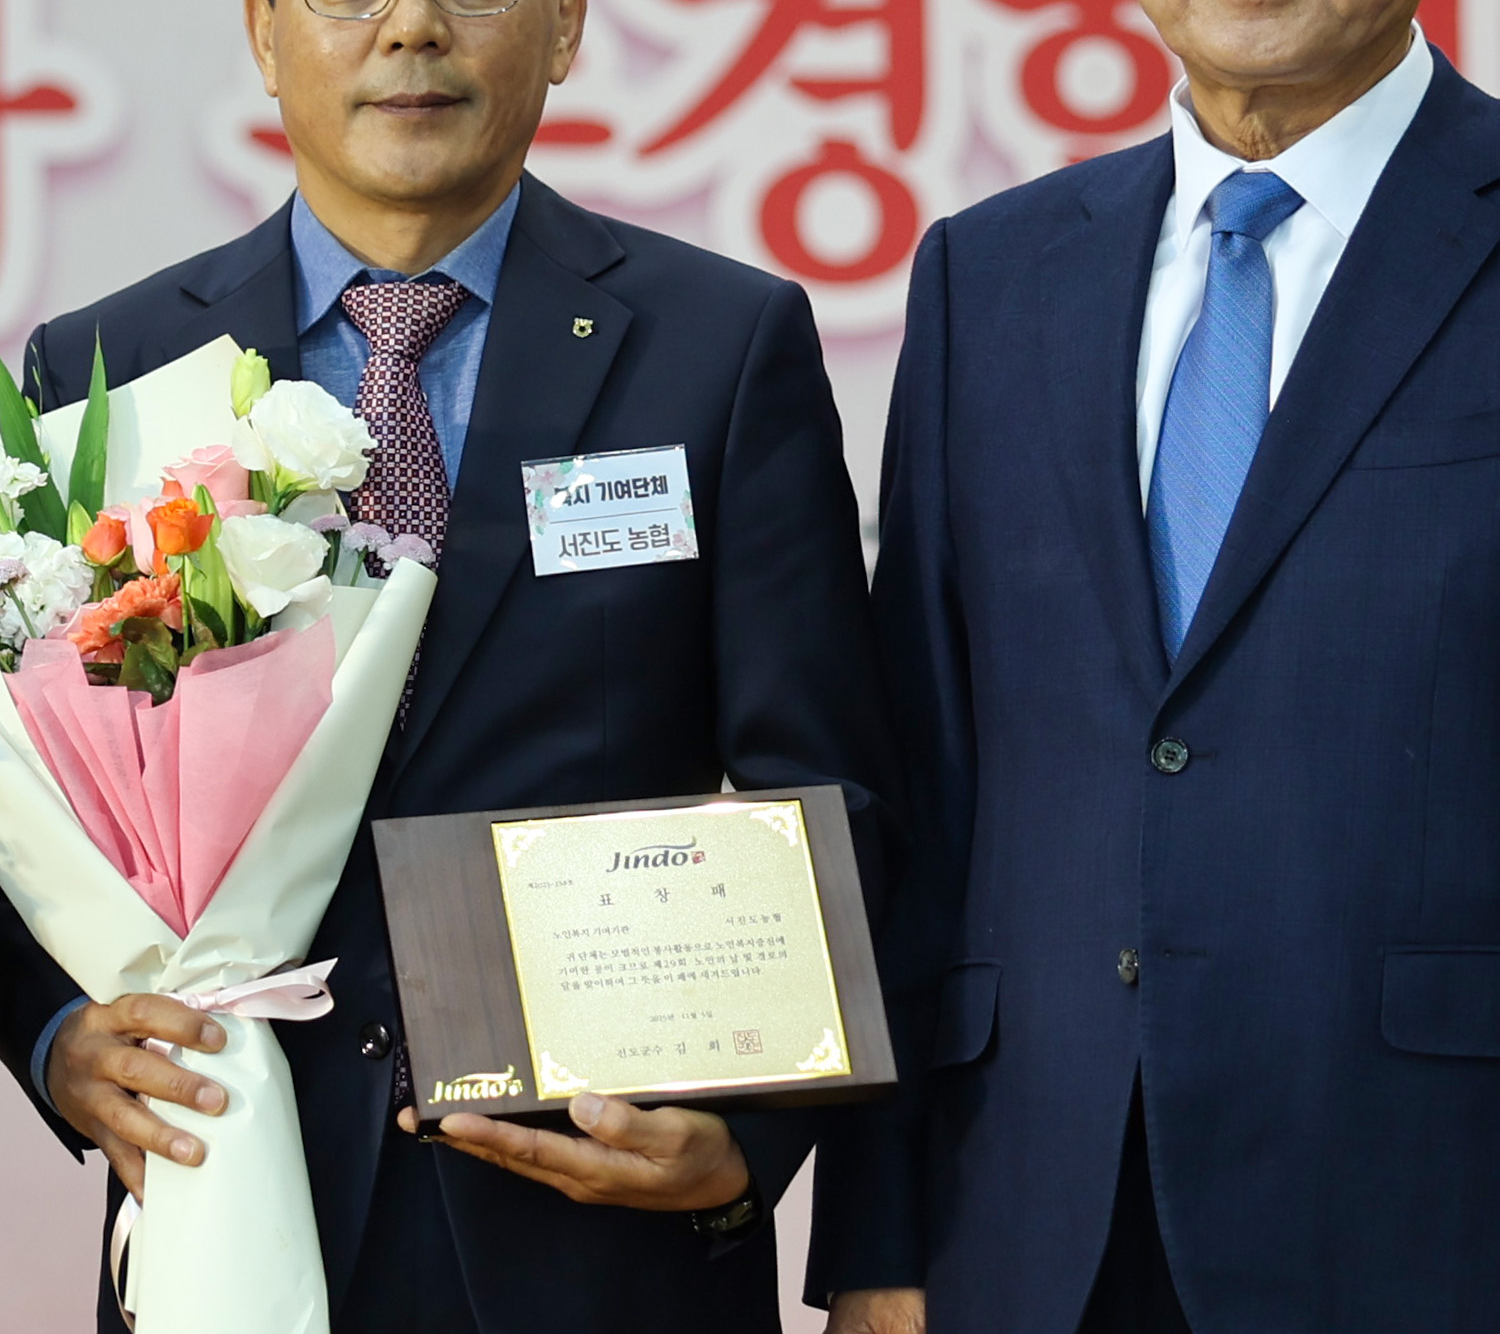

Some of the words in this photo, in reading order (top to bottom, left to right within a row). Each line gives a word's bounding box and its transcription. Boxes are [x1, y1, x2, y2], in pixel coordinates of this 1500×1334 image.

[595, 475, 669, 501] 기여단체
[559, 528, 622, 558] 서진도
[628, 524, 670, 551] 농협
[606, 845, 688, 873] Jindo
[599, 893, 614, 907] 표
[654, 887, 671, 904] 창
[711, 882, 726, 898] 패
[617, 1045, 663, 1059] 진도군수
[676, 1041, 686, 1055] 김
[429, 1073, 510, 1104] Jindo
